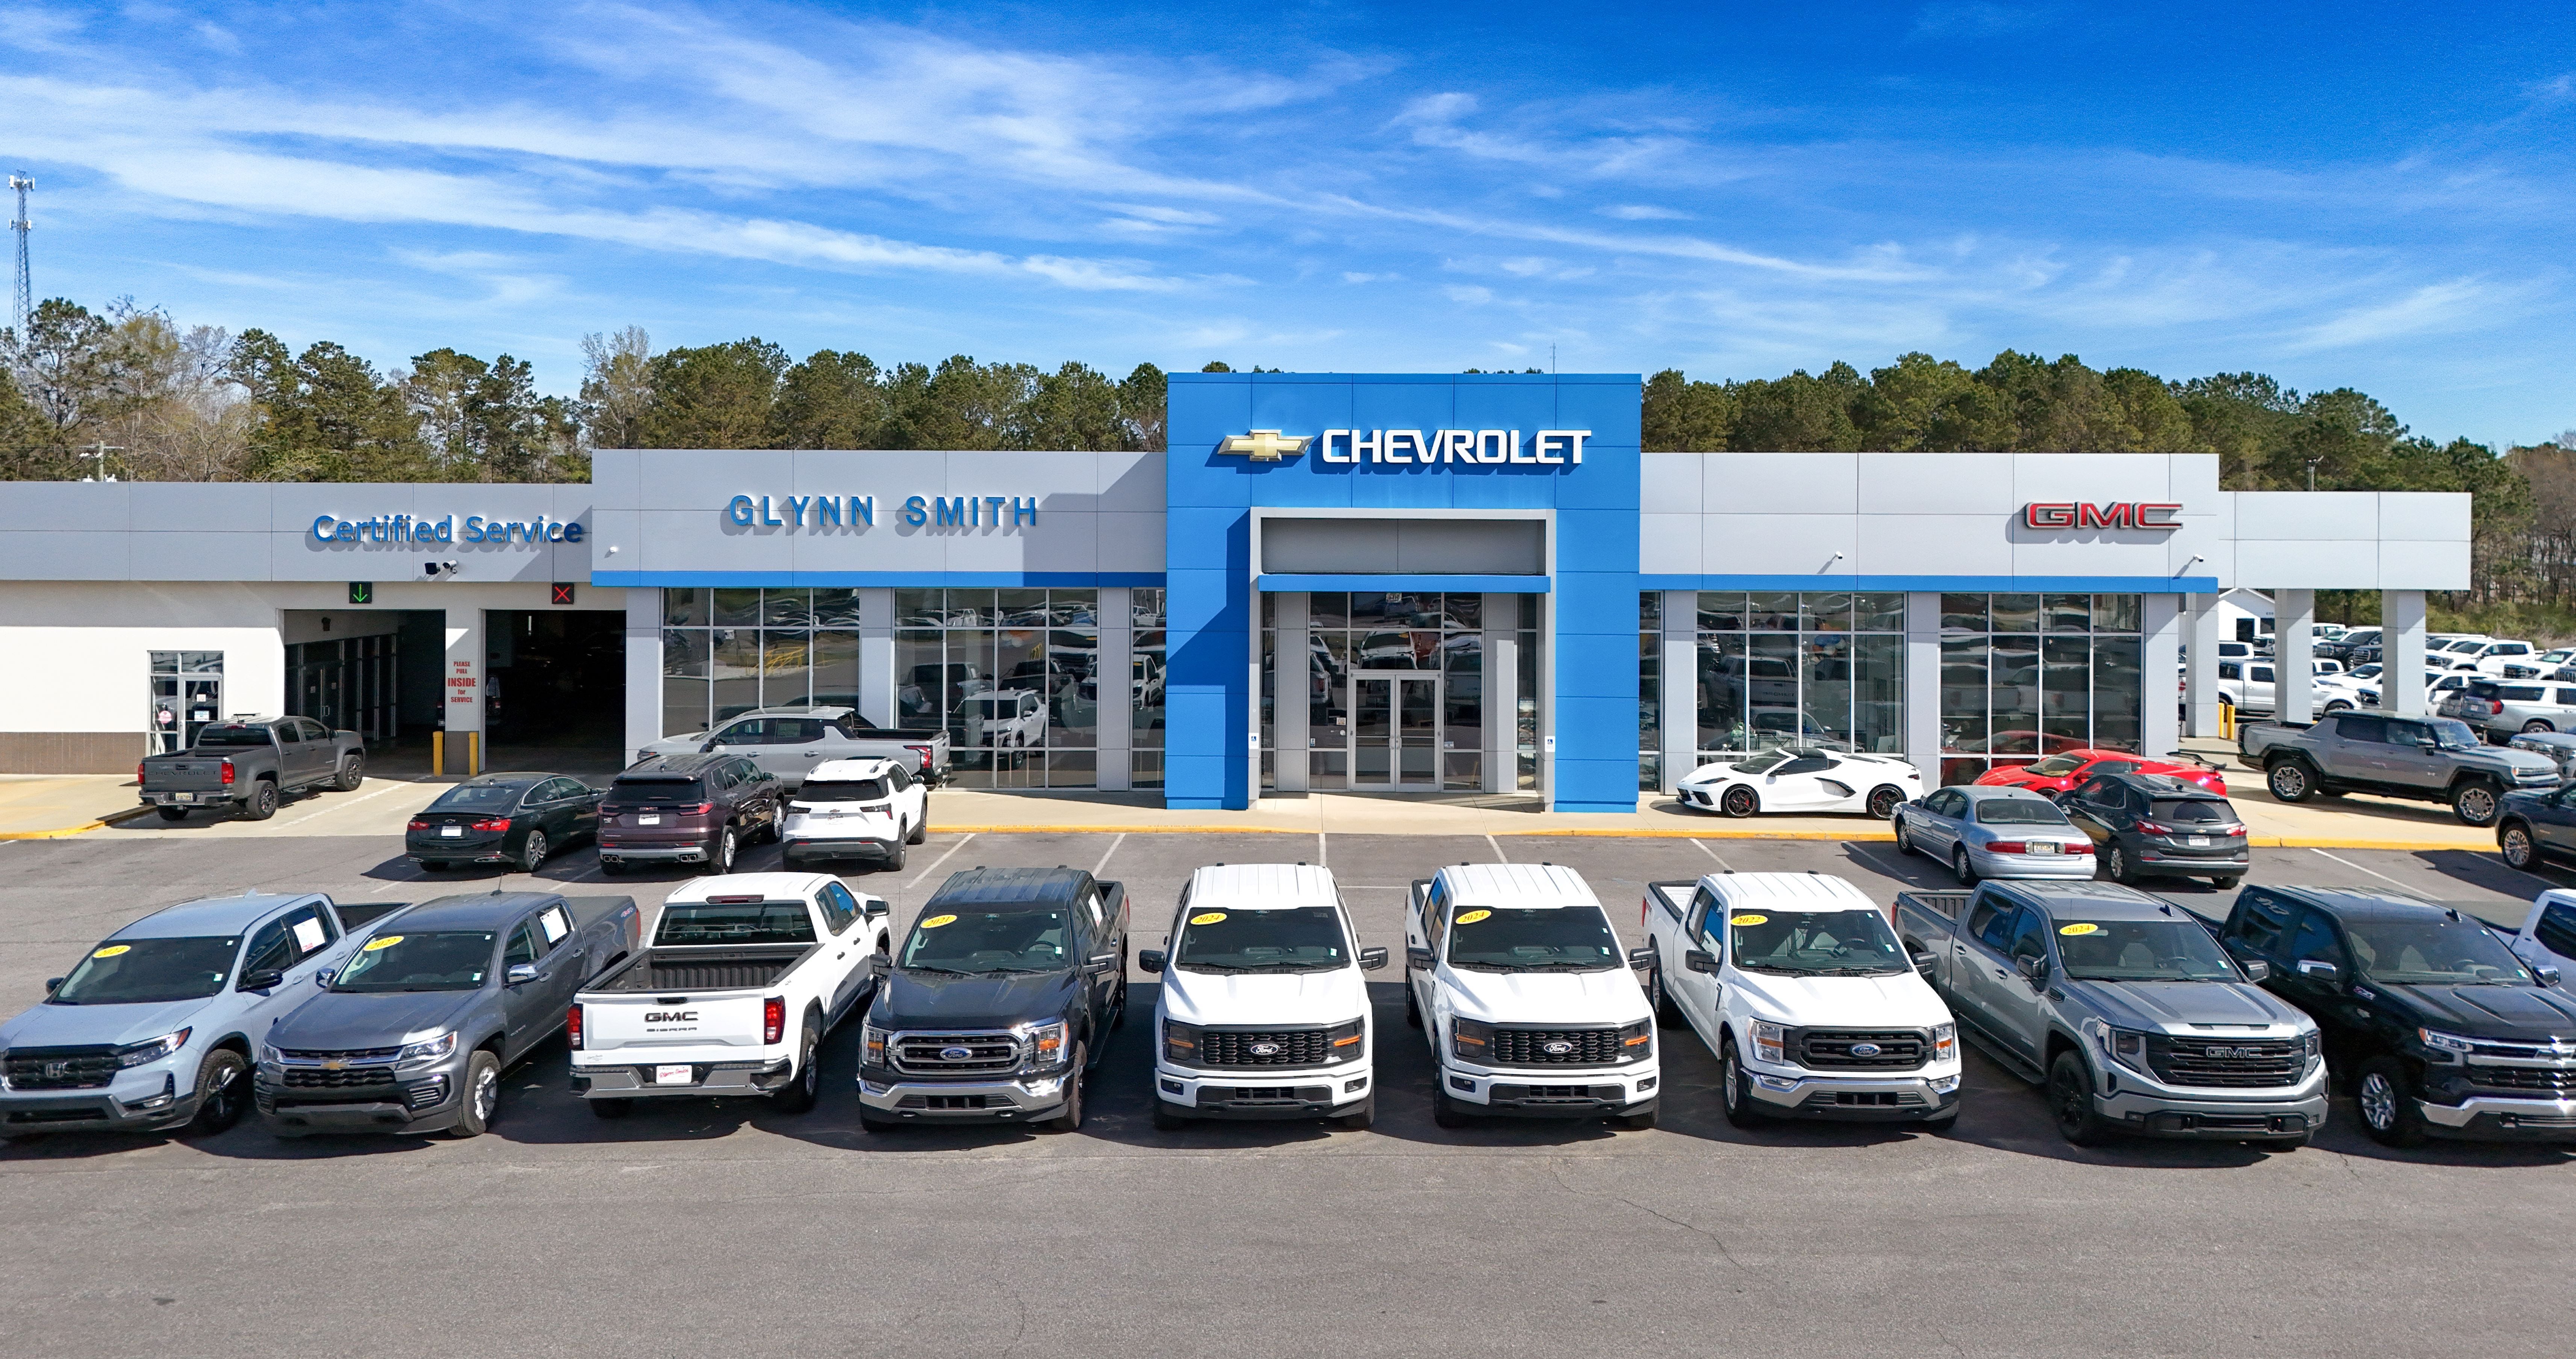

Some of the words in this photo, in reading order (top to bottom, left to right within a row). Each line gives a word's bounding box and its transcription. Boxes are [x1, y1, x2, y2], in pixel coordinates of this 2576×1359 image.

[1322, 429, 1592, 464] CHEVROLET
[730, 495, 874, 526] GLYNN
[905, 496, 1037, 526] SMITH
[2024, 501, 2183, 529] GMC
[313, 515, 453, 543] Certified
[465, 516, 584, 543] Service
[448, 678, 476, 687] INSIDE
[927, 916, 950, 927] 2021
[1196, 914, 1221, 923] 2024
[1462, 912, 1485, 922] 2024
[2067, 925, 2090, 934] 2024
[370, 938, 397, 949] 2022
[645, 1012, 698, 1023] GMC
[2206, 1046, 2262, 1058] GMC
